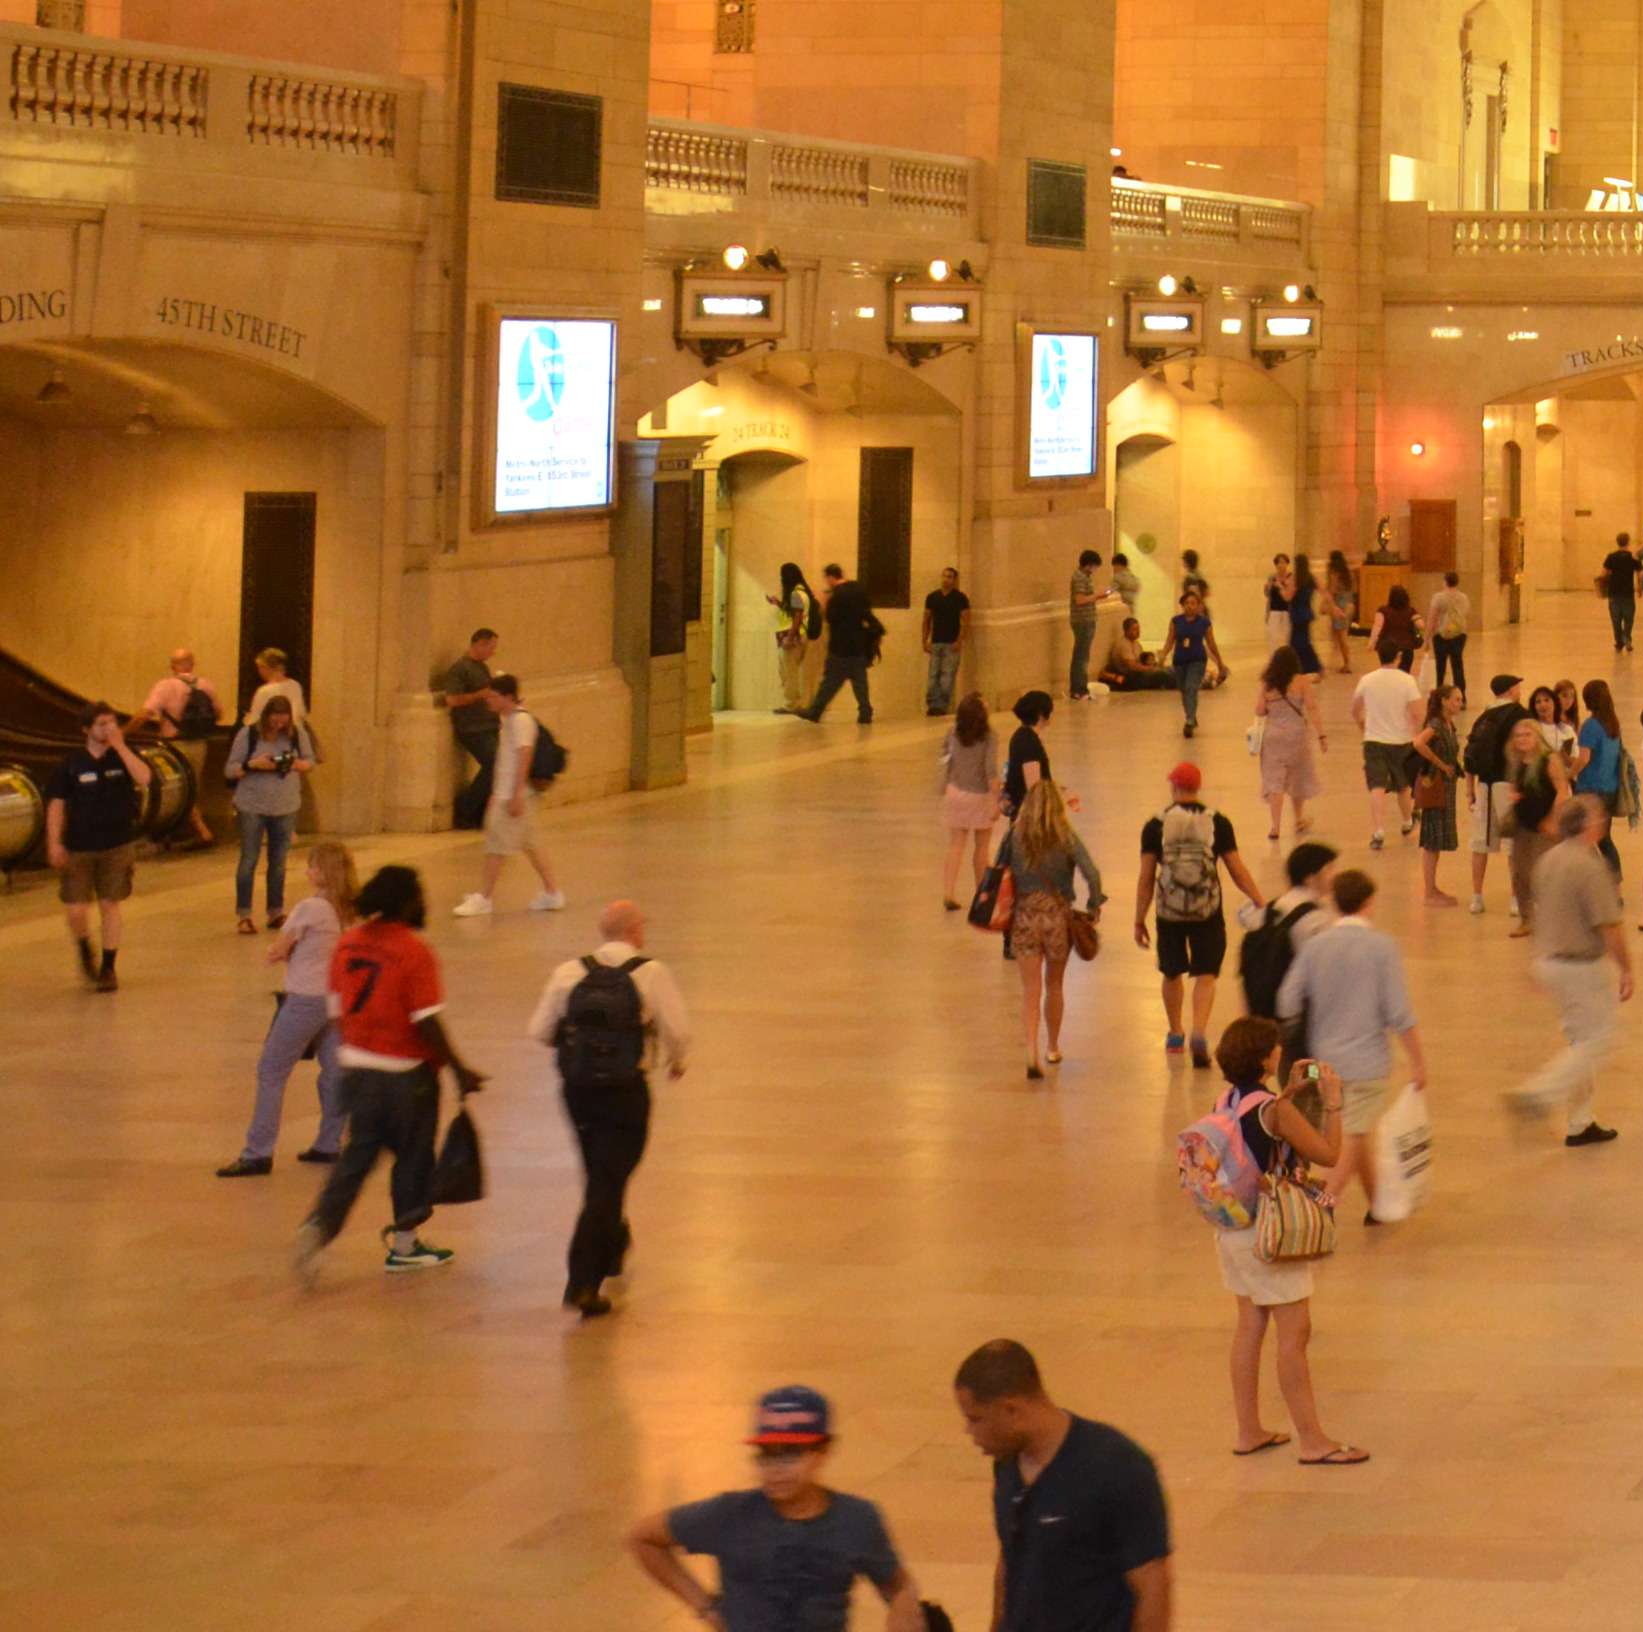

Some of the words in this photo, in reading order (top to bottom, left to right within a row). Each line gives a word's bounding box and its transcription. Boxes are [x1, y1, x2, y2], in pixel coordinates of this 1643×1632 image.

[157, 297, 217, 332] 45TH
[221, 308, 307, 358] STREET
[746, 423, 776, 438] TRACK
[346, 958, 382, 1014] 7
